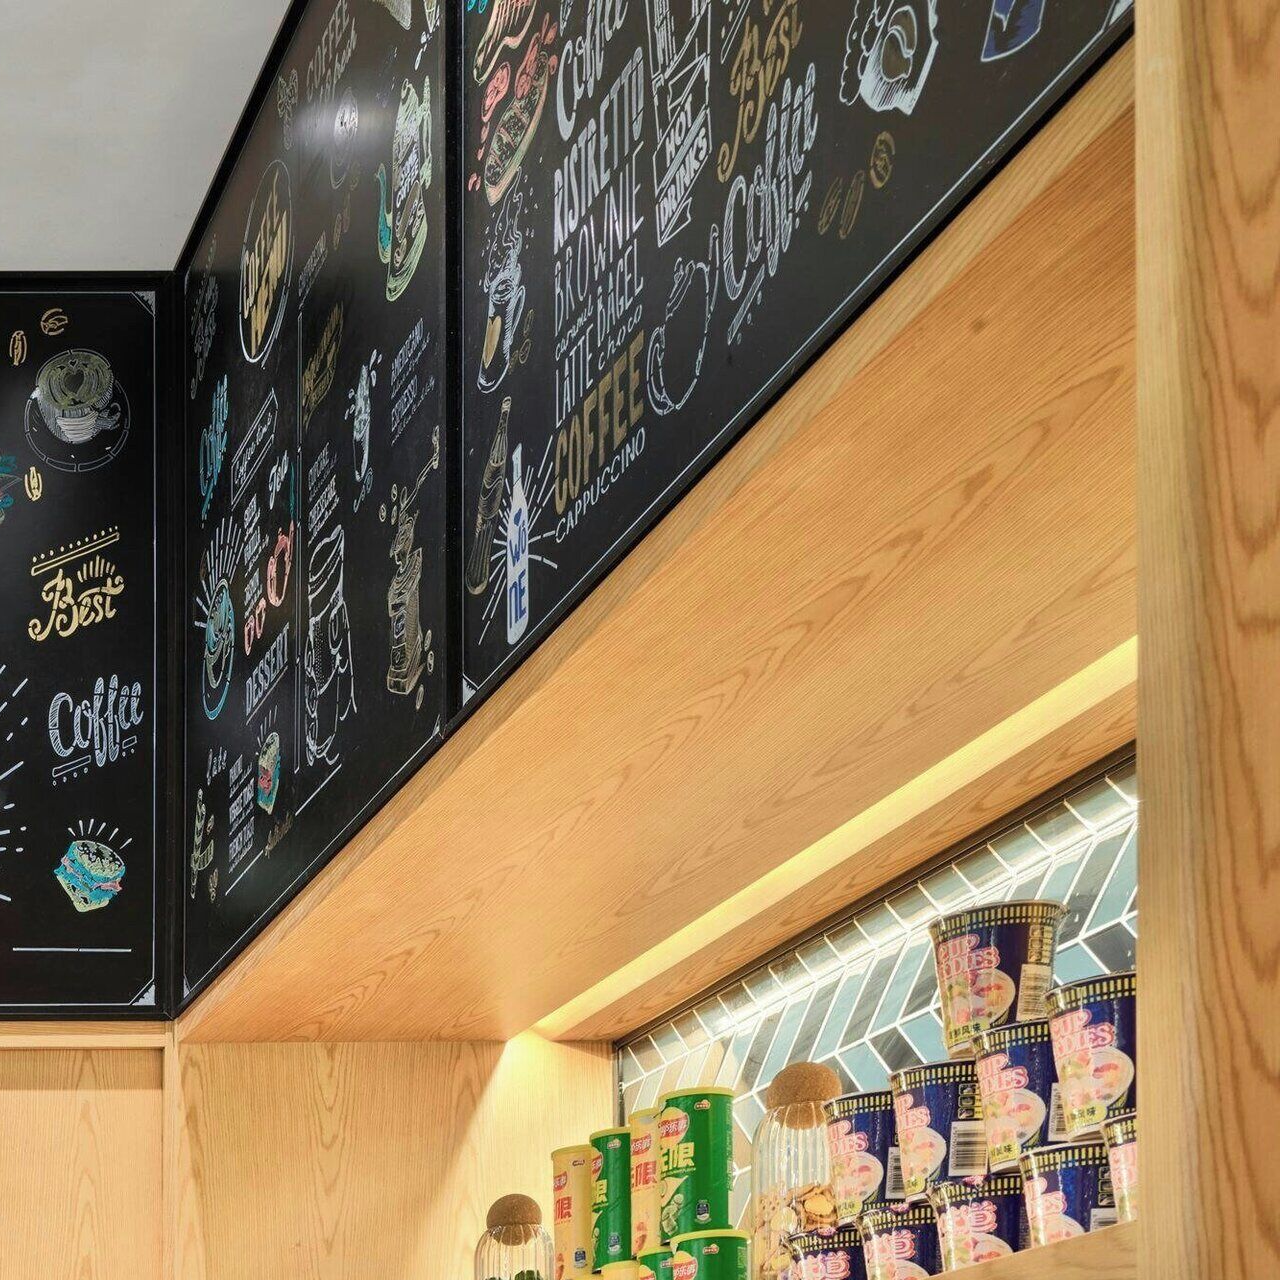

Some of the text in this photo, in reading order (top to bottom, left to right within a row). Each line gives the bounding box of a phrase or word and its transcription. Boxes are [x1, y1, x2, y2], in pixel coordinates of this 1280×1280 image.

[554, 46, 644, 247] RISTRETTO
[660, 131, 709, 229] DRINKS
[665, 95, 694, 164] HOT
[722, 63, 818, 301] Coffee
[243, 166, 279, 320] COFFEE
[251, 209, 287, 357] MENU
[555, 141, 644, 321] BROWNIE
[597, 246, 644, 343] BAGEL
[598, 303, 643, 370] choco
[555, 336, 644, 514] COFFEE
[556, 320, 593, 428] LATTE
[269, 450, 288, 509] Tea
[556, 427, 646, 544] CAPPUCCINO
[48, 674, 144, 767] Coffee
[246, 622, 289, 716] DESSERT
